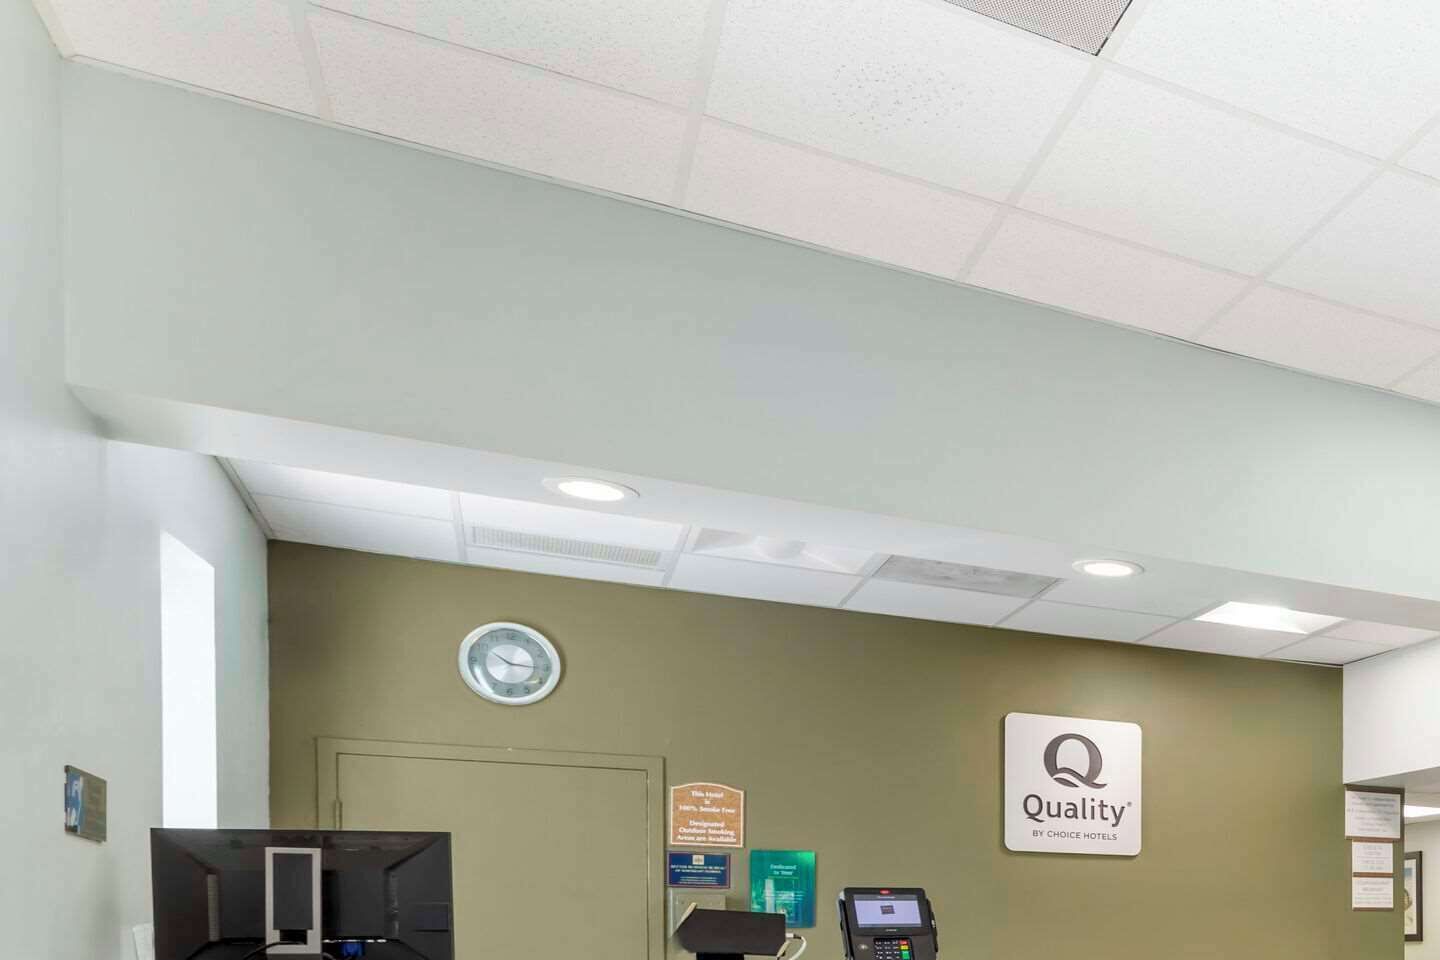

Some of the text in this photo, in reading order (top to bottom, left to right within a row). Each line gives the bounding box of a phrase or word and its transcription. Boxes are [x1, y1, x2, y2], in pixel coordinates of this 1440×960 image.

[1023, 794, 1125, 827] Quality
[1047, 830, 1081, 839] CHOICE
[1083, 832, 1118, 841] HOTELS
